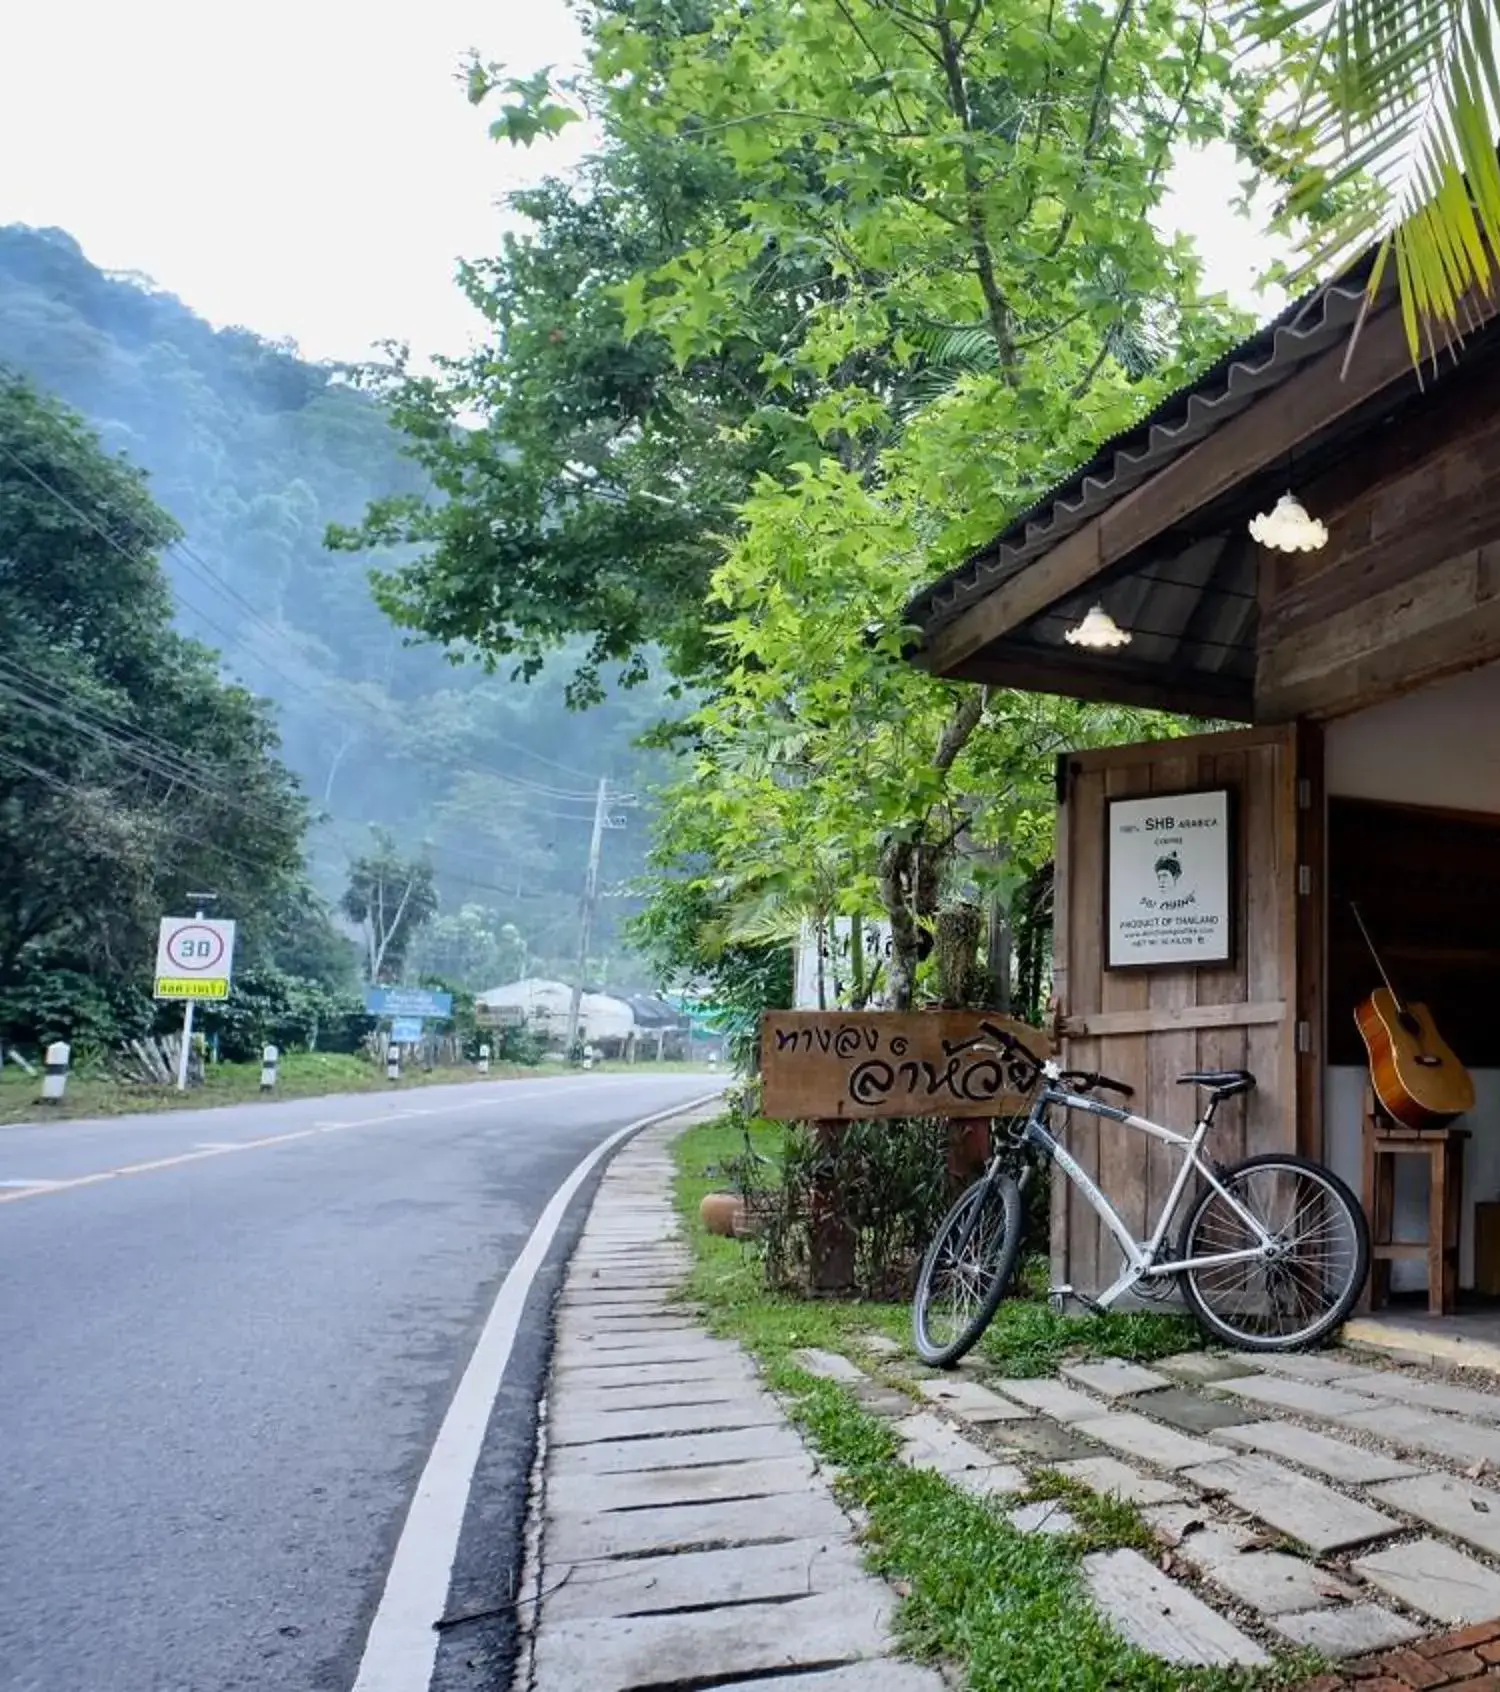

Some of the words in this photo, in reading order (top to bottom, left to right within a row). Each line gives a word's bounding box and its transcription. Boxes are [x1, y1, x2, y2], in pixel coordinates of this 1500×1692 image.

[1145, 816, 1175, 831] SHB
[1120, 917, 1159, 929] PRODUCT
[1161, 917, 1172, 927] OF
[1175, 915, 1219, 926] THAILAND
[181, 940, 210, 957] 30
[775, 1025, 879, 1059] ทางลง
